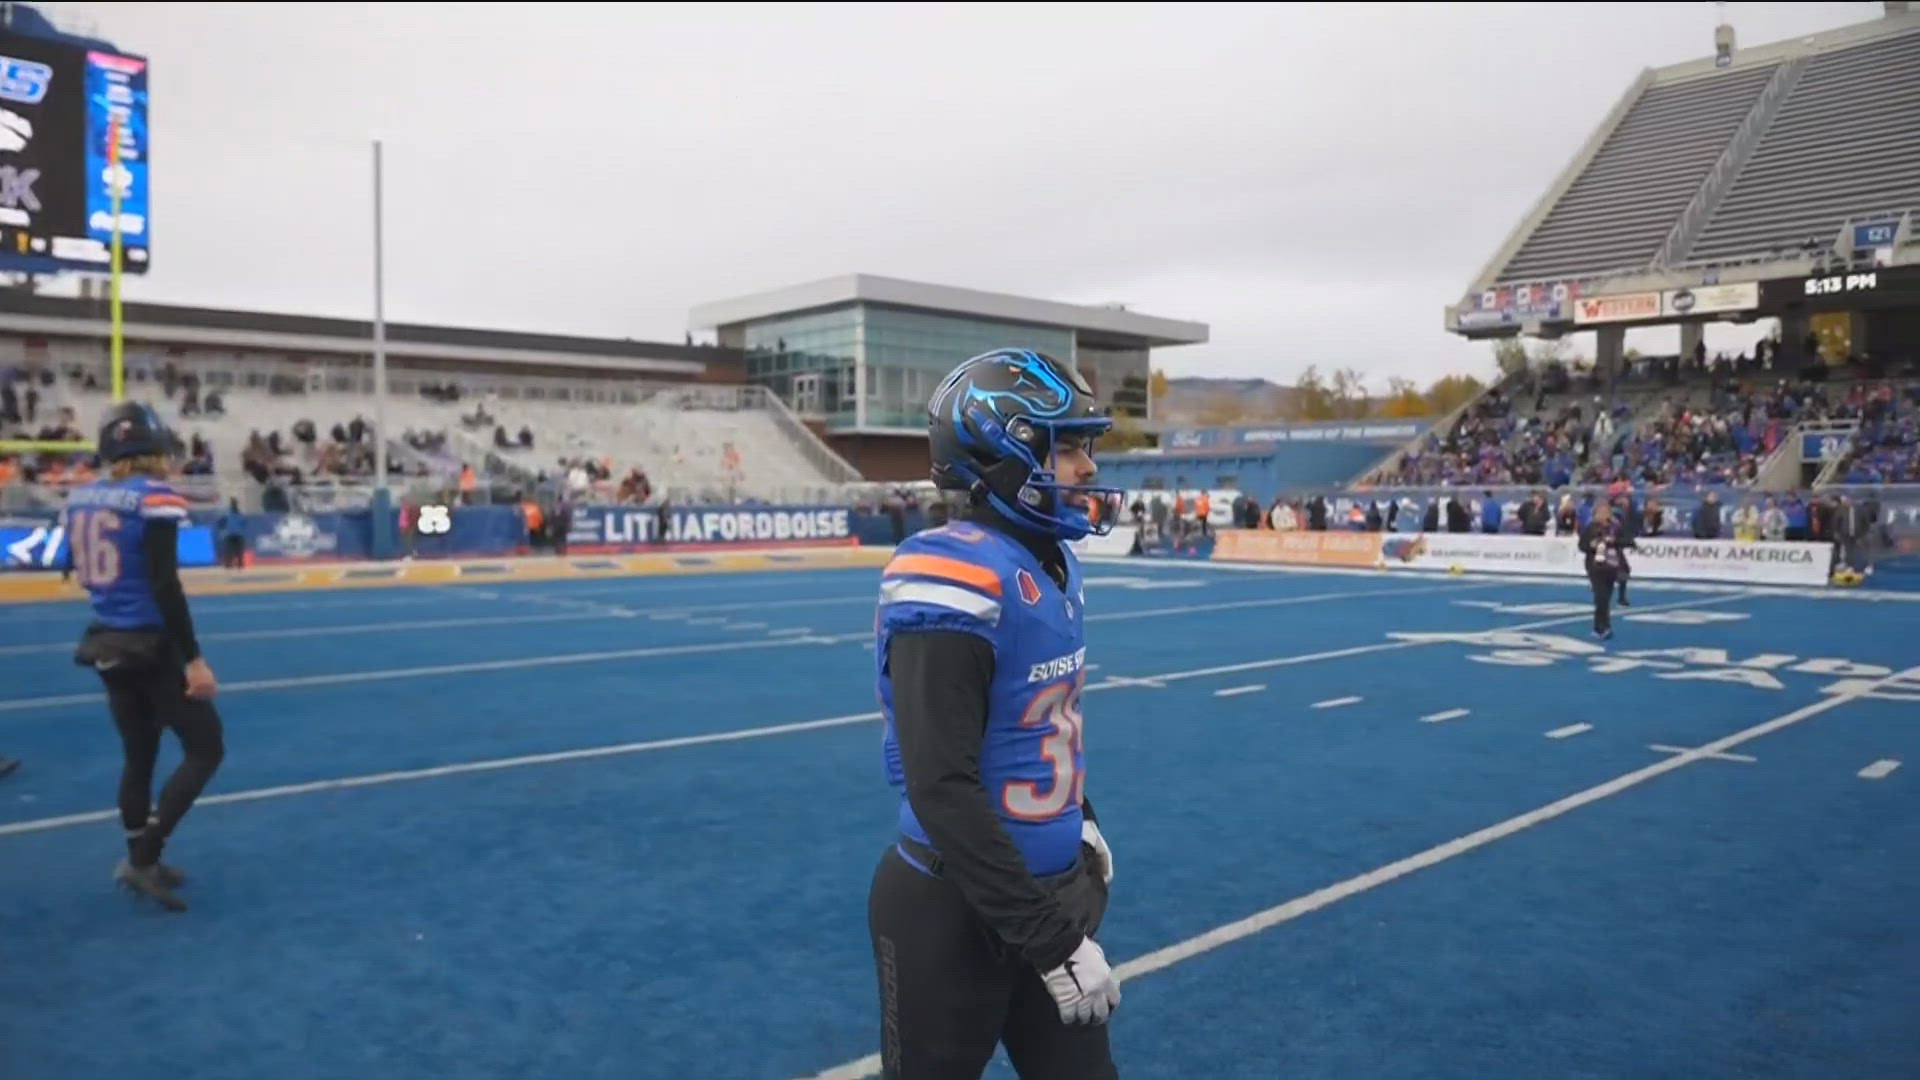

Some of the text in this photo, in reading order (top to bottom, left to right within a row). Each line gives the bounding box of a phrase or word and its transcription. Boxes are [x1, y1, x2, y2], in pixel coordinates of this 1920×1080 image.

[1804, 272, 1877, 296] 5:13 PM
[68, 508, 122, 588] 16
[1632, 543, 1815, 564] MOUNTAIN AMERICA
[1028, 654, 1074, 683] BOISE
